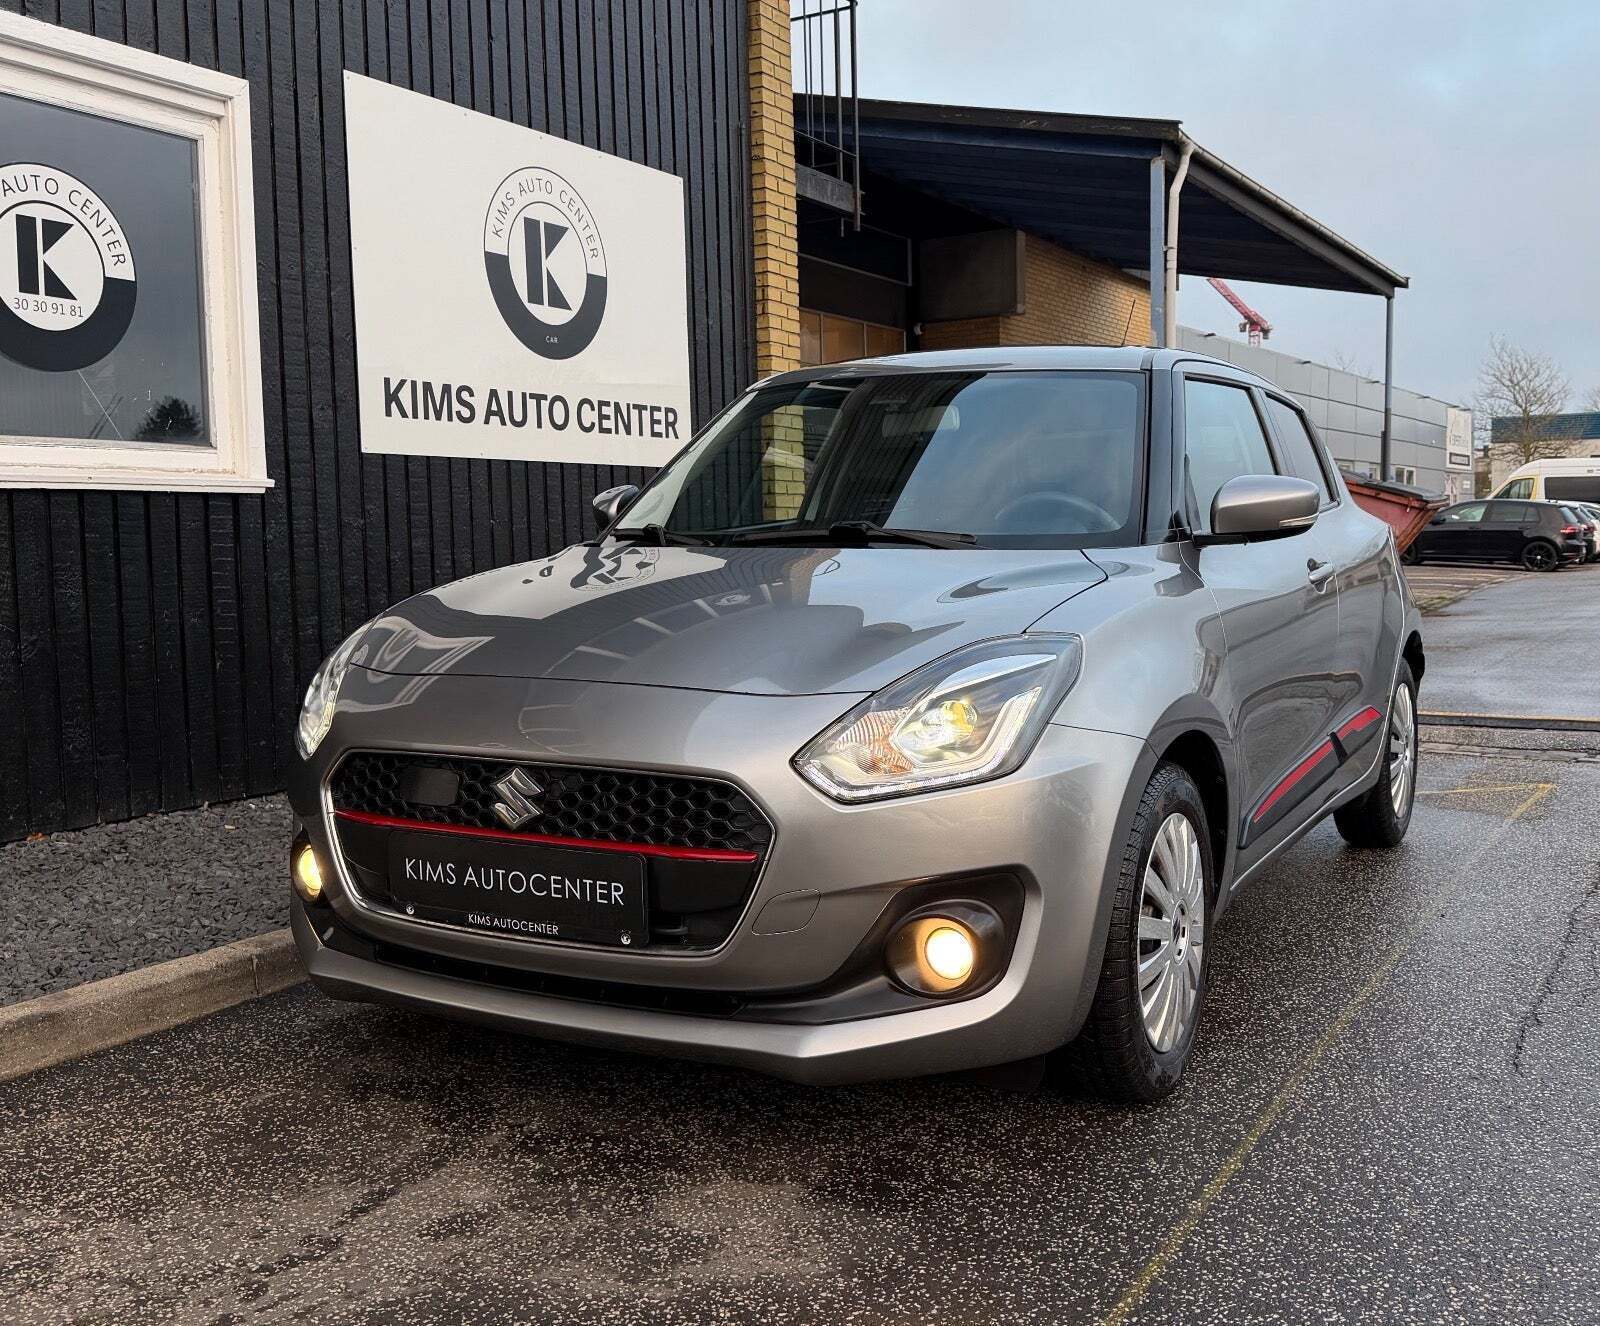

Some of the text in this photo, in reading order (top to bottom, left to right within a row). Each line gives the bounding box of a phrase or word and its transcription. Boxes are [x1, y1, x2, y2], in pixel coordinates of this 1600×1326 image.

[1, 174, 126, 267] AUTO CENTER
[492, 178, 598, 259] KIMS AUTO CENTER
[14, 297, 84, 318] 30 30 91 81
[383, 376, 680, 440] KIMS AUTO CENTER
[405, 857, 625, 906] KIMS AUTOCENTER
[468, 913, 560, 936] KIMS AUTOCENTER
